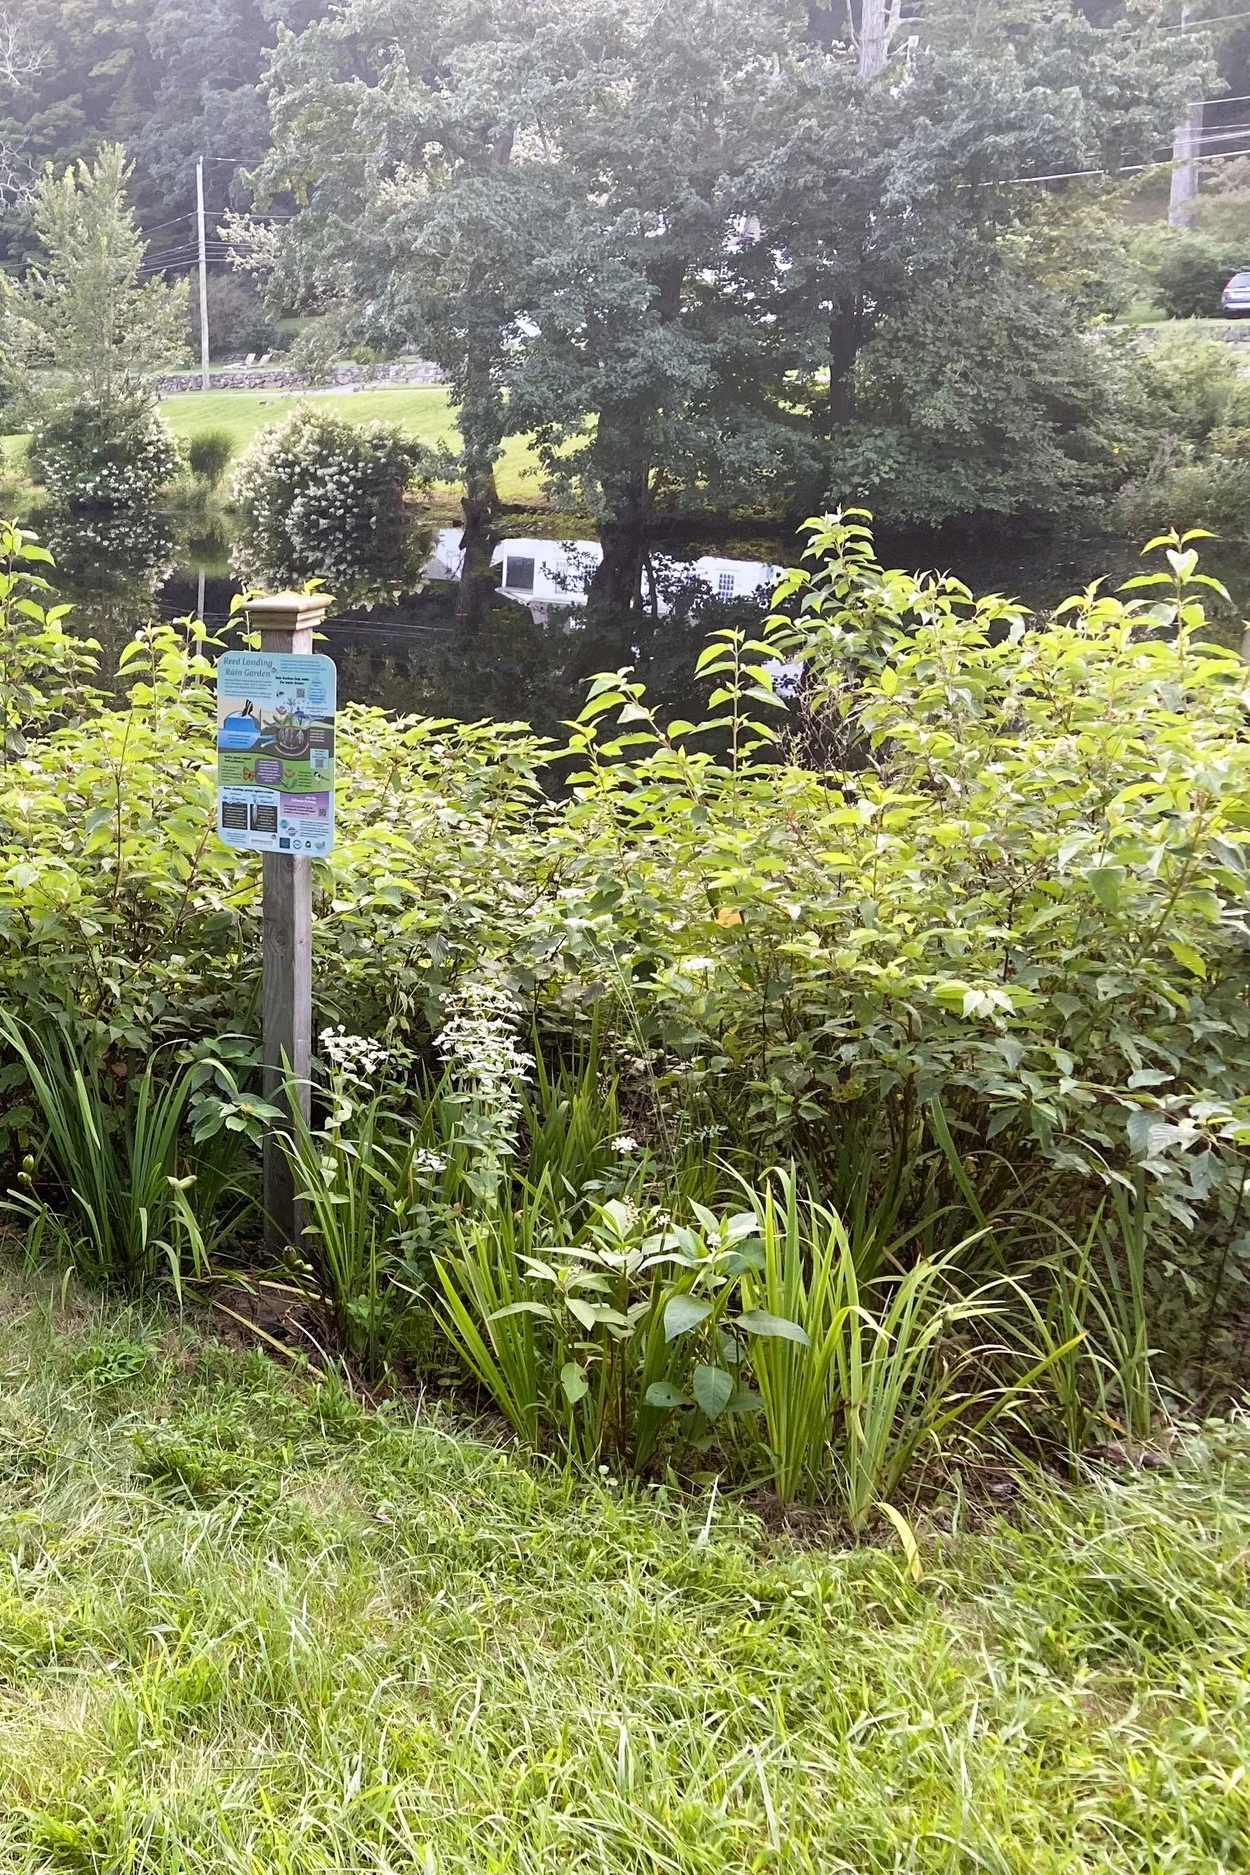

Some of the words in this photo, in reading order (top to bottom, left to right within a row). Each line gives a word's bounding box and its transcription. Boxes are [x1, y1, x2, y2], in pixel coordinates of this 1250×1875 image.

[223, 657, 240, 666] Reed
[242, 658, 273, 668] Landing
[225, 668, 242, 676] Rain
[244, 669, 271, 677] Garden
